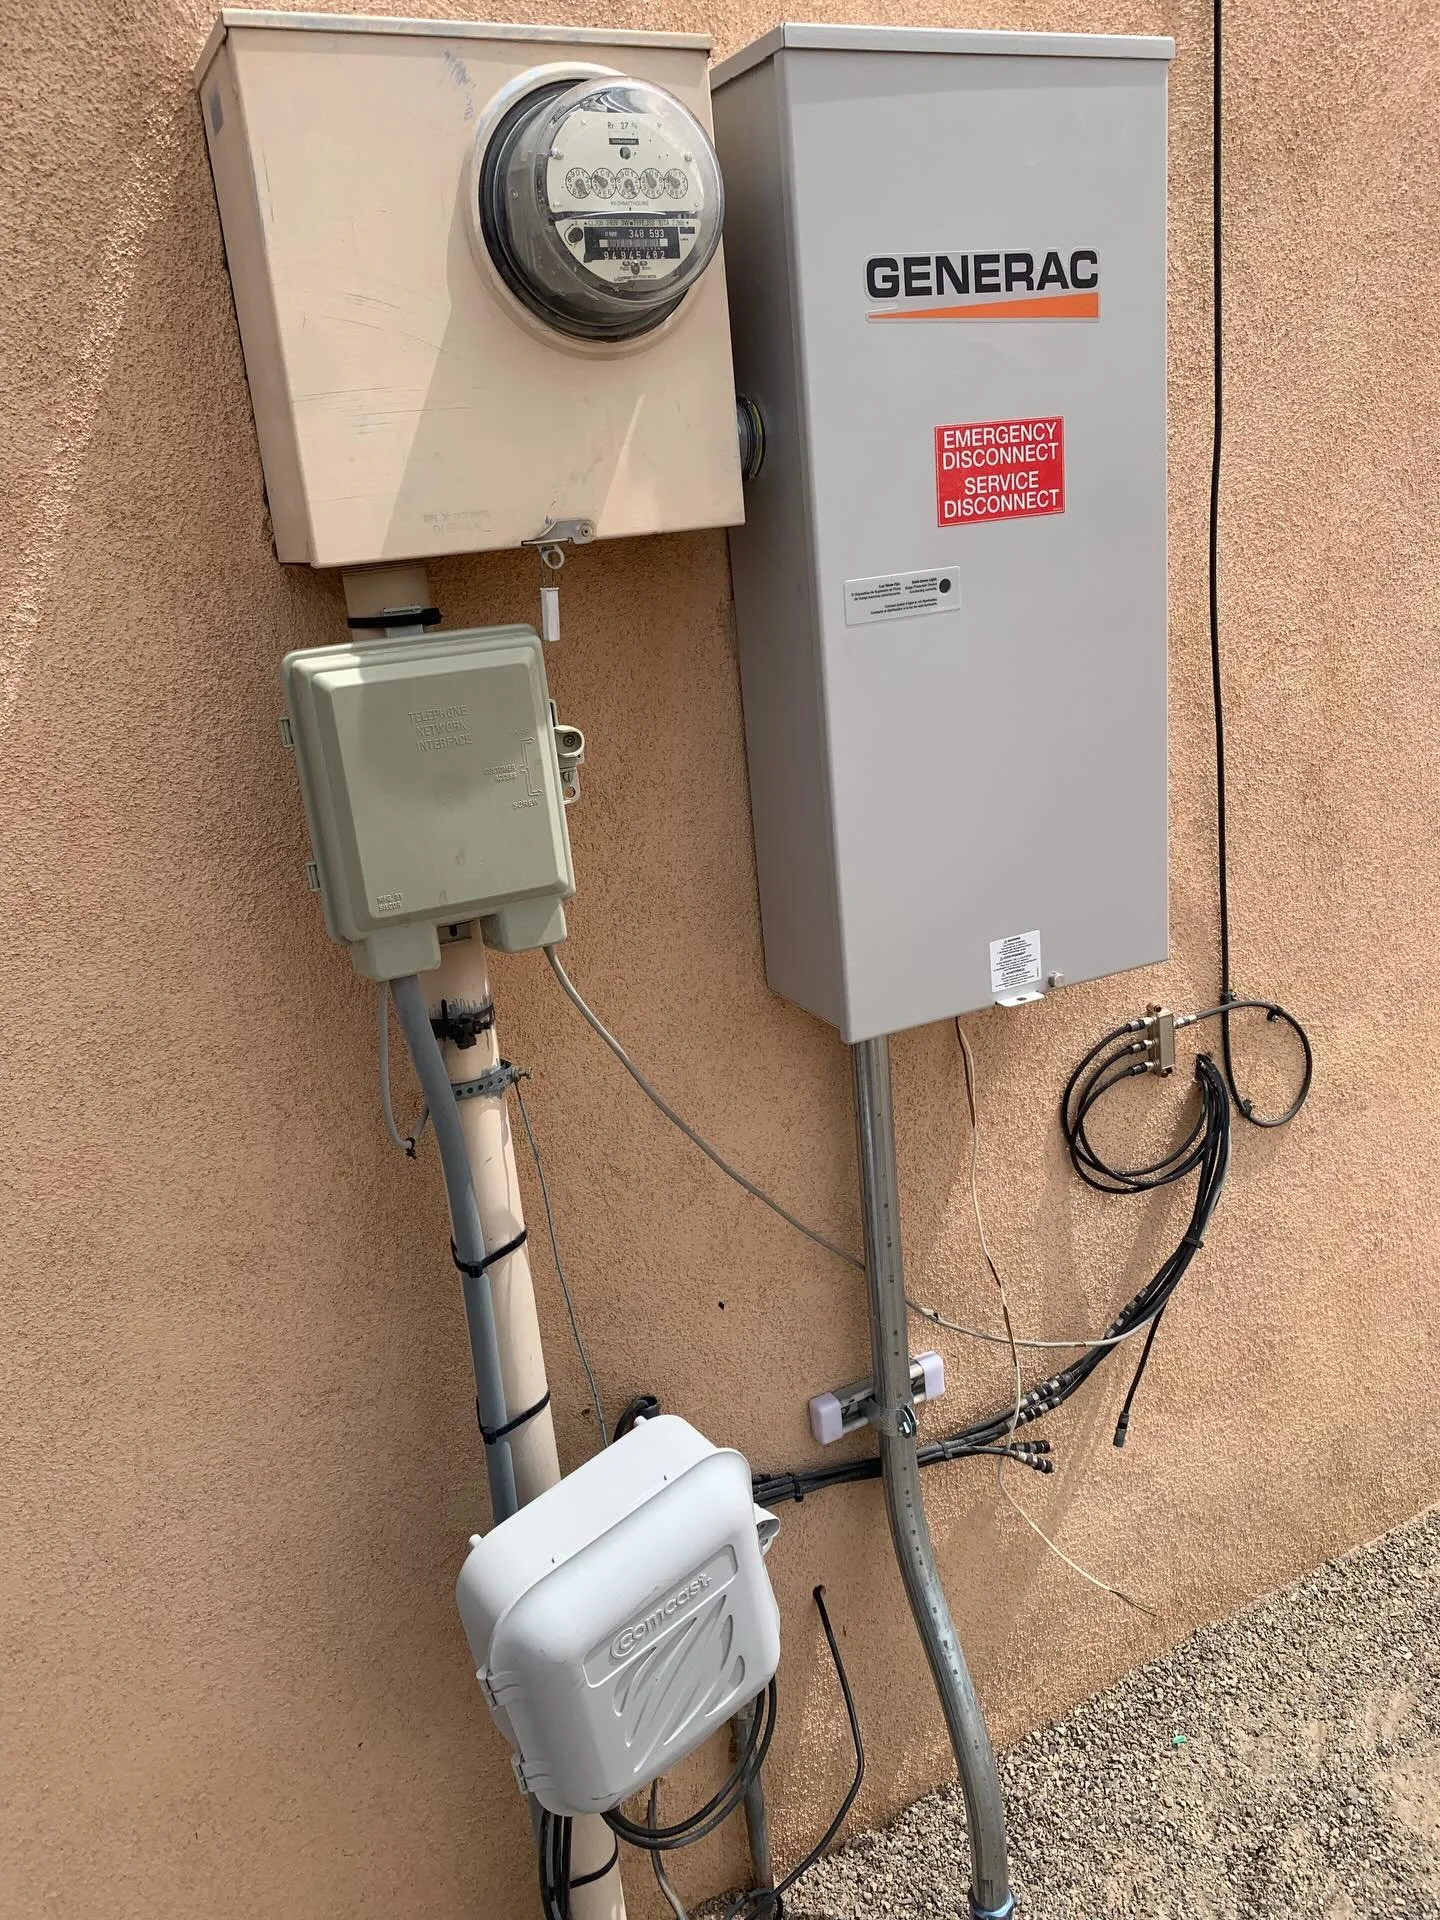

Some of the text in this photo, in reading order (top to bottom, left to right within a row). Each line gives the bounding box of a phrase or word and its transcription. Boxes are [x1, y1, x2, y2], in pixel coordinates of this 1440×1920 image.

[620, 121, 629, 130] 27
[629, 229, 645, 239] 348
[649, 229, 665, 239] 593
[866, 250, 1099, 299] GENERAC
[943, 422, 1057, 449] EMERGENCY
[942, 442, 1059, 470] DISCONNECT
[964, 470, 1039, 496] SERVICE
[944, 488, 1060, 519] DISCONNECT
[407, 703, 469, 723] TELEPHONE
[415, 719, 467, 739] NETWORK
[416, 733, 473, 753] INTERFACE
[609, 1573, 712, 1661] Comcast
